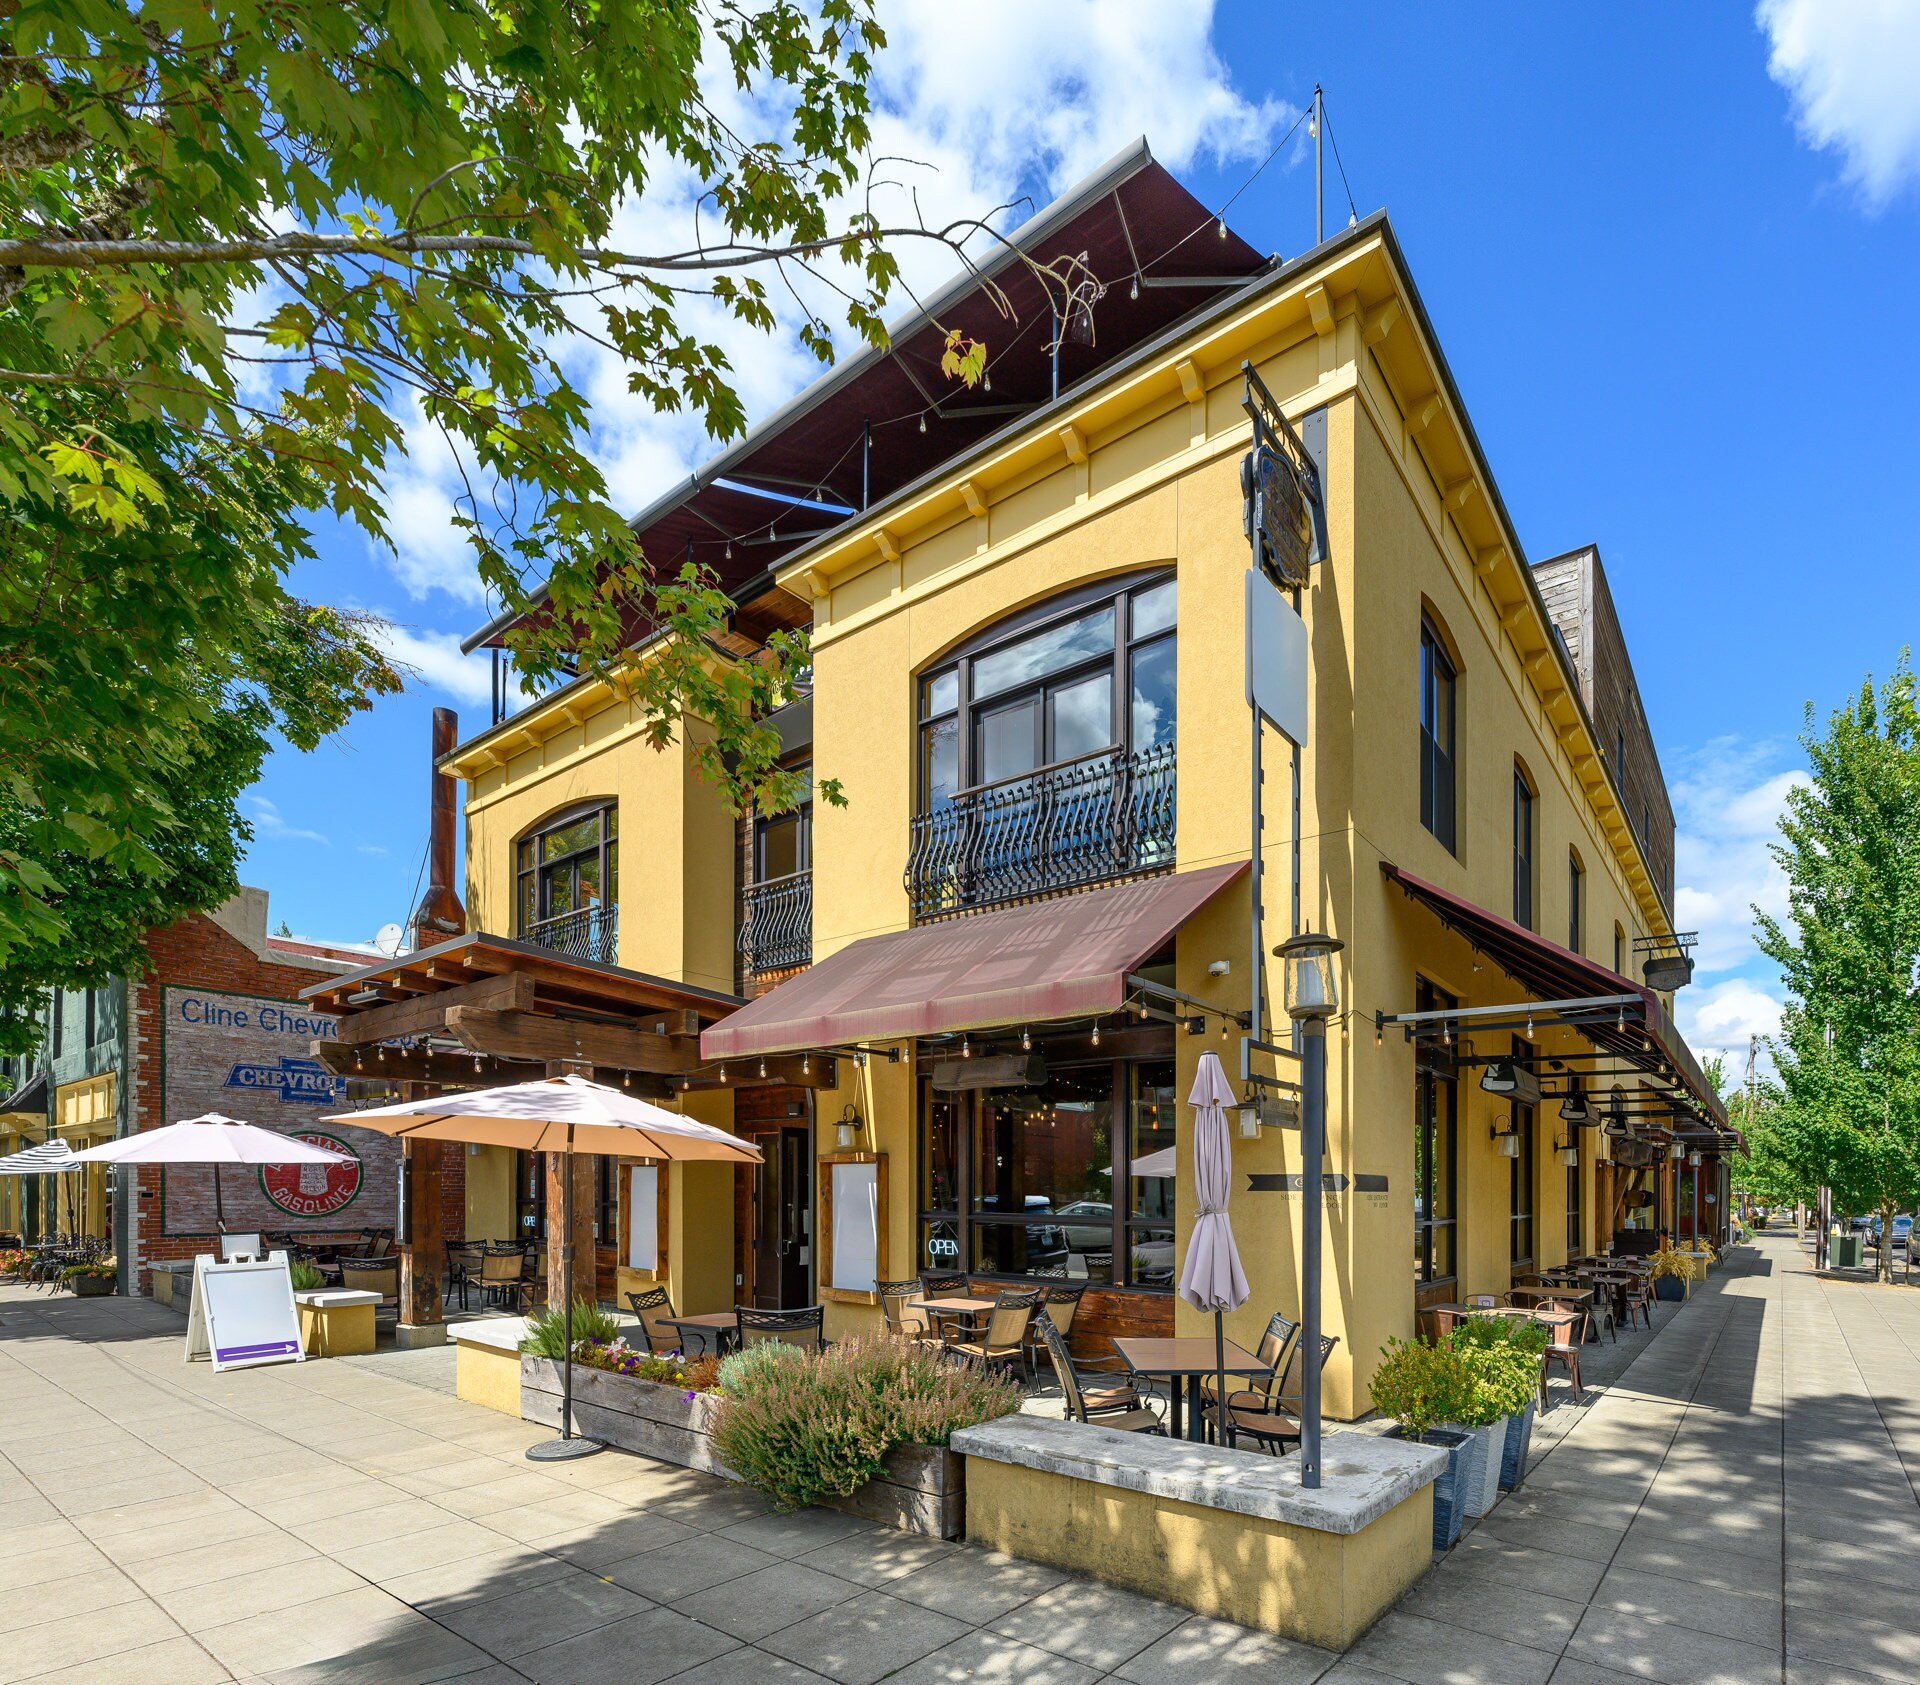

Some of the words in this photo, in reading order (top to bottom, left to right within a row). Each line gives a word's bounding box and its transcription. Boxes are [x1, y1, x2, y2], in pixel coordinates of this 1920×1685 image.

[181, 998, 249, 1029] Cline
[238, 1068, 346, 1092] CHEVROL
[273, 1184, 354, 1213] GASOLINE
[523, 1215, 536, 1227] OPE
[928, 1238, 959, 1256] OPEN
